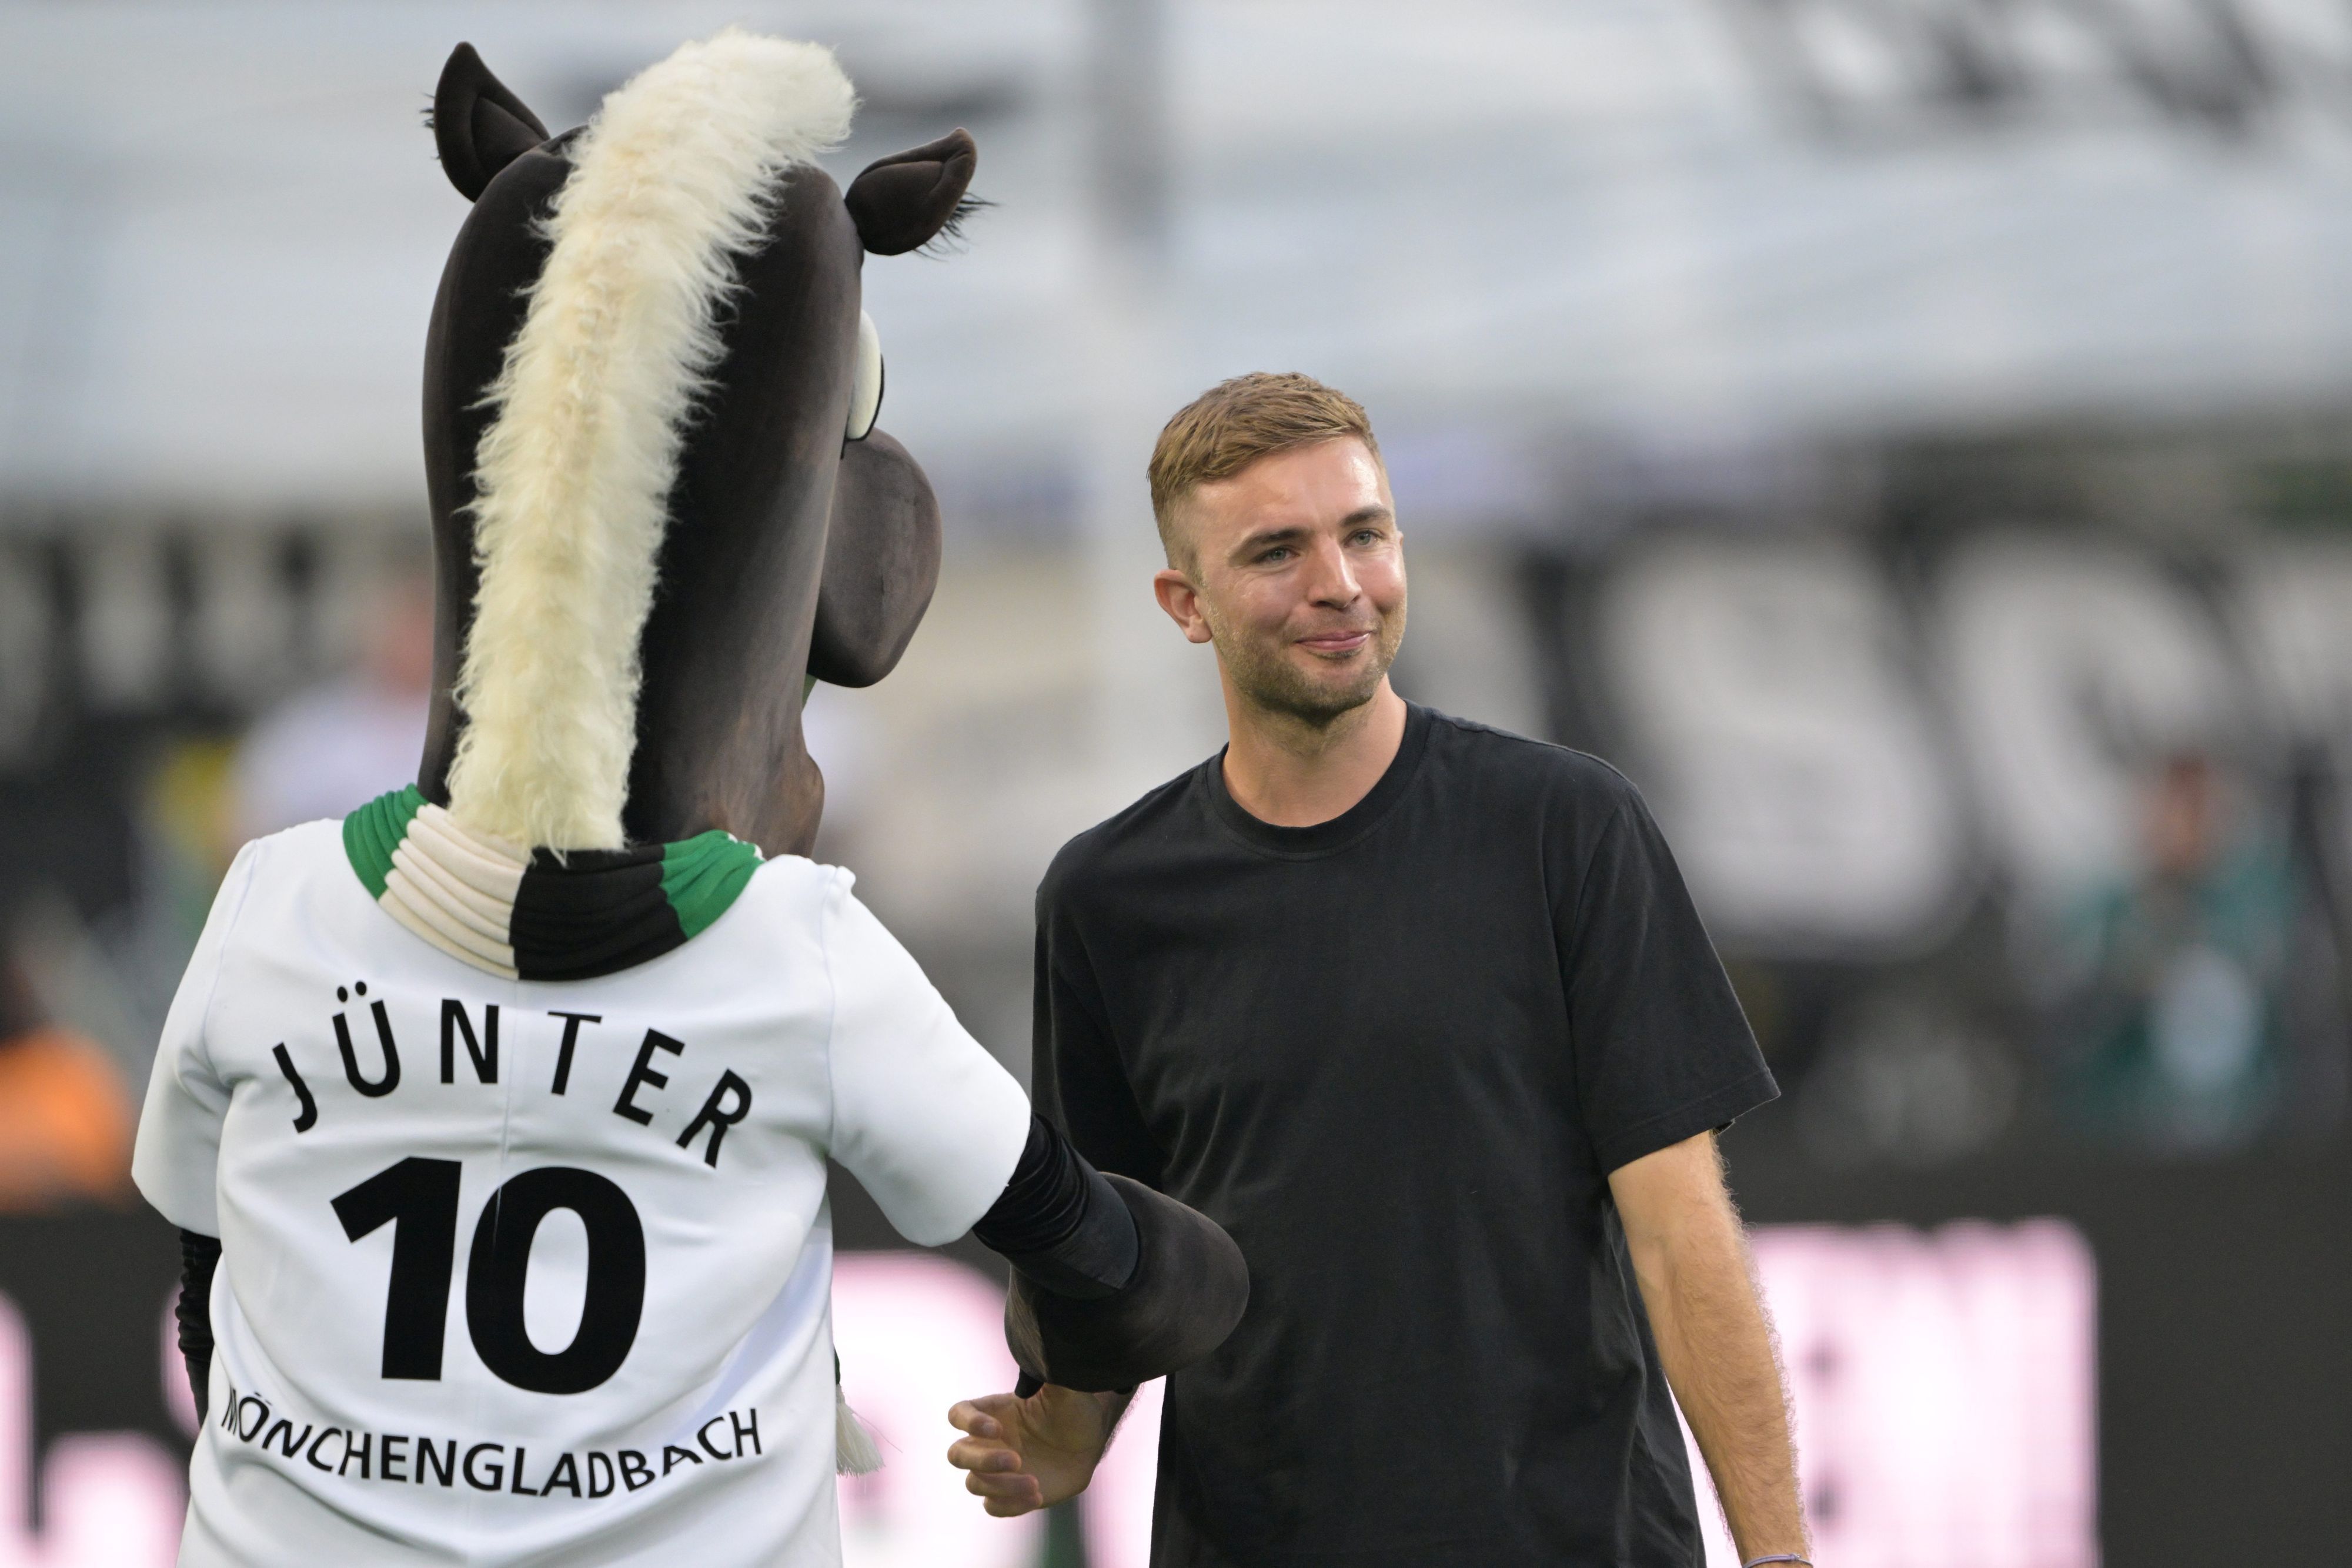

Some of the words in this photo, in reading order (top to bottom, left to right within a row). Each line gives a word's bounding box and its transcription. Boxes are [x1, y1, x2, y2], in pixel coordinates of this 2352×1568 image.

[272, 981, 752, 1168] JÜNTER
[330, 1156, 646, 1395] 10
[221, 1386, 762, 1499] MÖNCHENGLADBACH
